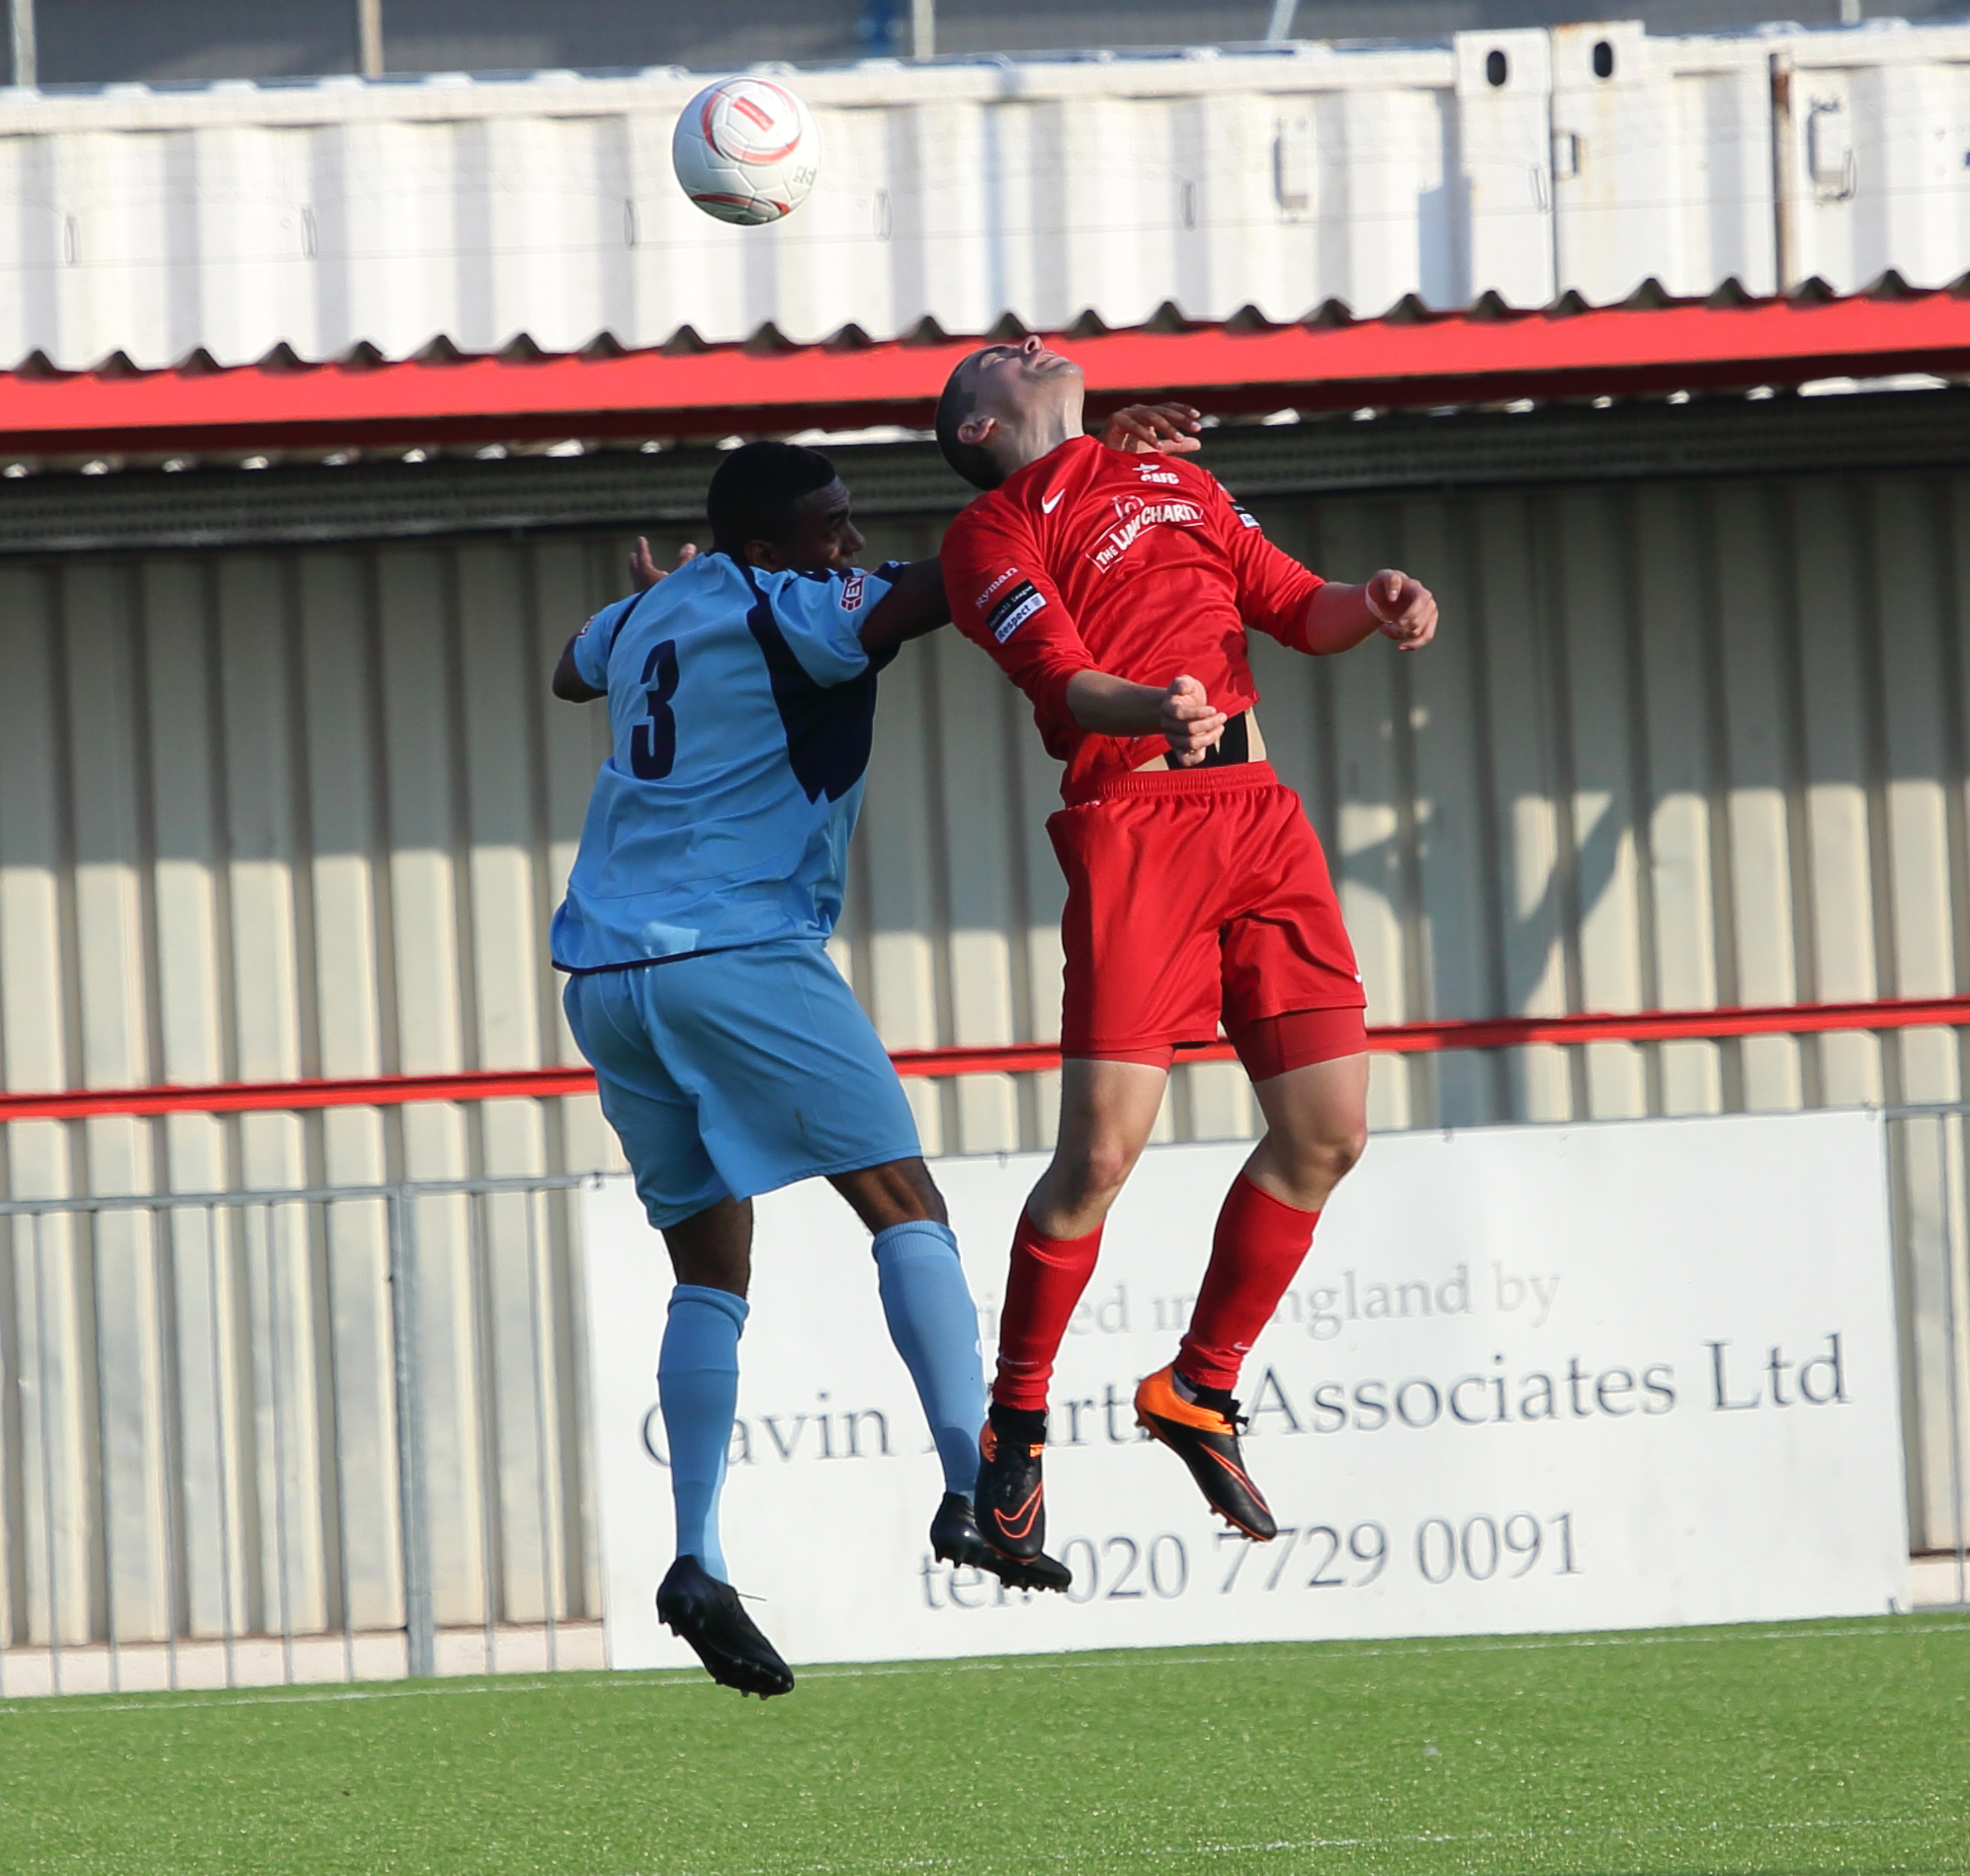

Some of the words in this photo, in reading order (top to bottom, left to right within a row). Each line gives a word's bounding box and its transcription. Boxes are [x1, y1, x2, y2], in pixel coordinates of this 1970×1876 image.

[975, 566, 1019, 610] Ryman
[1095, 545, 1119, 564] THE
[996, 604, 1032, 641] Respect
[631, 639, 681, 780] 3
[1273, 1262, 1475, 1341] ngland
[1490, 1262, 1563, 1328] by
[1245, 1353, 1678, 1436] Associates
[1706, 1333, 1851, 1411] Ltd
[1057, 1534, 1190, 1604] 020
[1213, 1521, 1390, 1594] 7729
[1413, 1510, 1584, 1584] 0091
